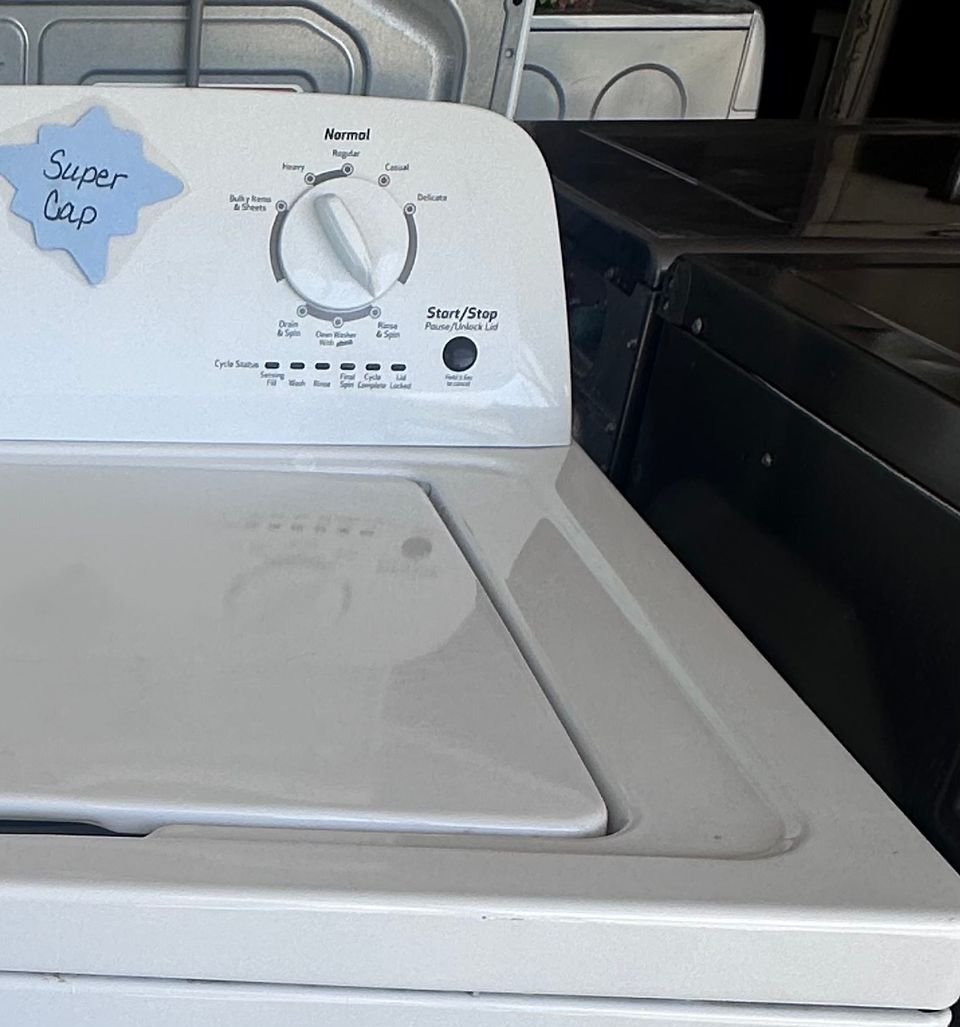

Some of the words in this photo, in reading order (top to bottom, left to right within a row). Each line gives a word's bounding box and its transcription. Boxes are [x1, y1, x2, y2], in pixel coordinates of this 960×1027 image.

[324, 128, 370, 141] Normal
[332, 149, 360, 159] Regular
[43, 149, 128, 190] Super
[384, 163, 409, 171] Casual
[417, 193, 447, 201] Delicate
[43, 189, 97, 230] Cap
[242, 203, 266, 211] Sheets
[426, 306, 498, 323] Start/Stop
[278, 320, 299, 328] Drain
[378, 321, 398, 329] Rinse
[424, 321, 482, 332] Pause/Unlock
[484, 322, 499, 331] Lid
[214, 359, 234, 370] Cycle
